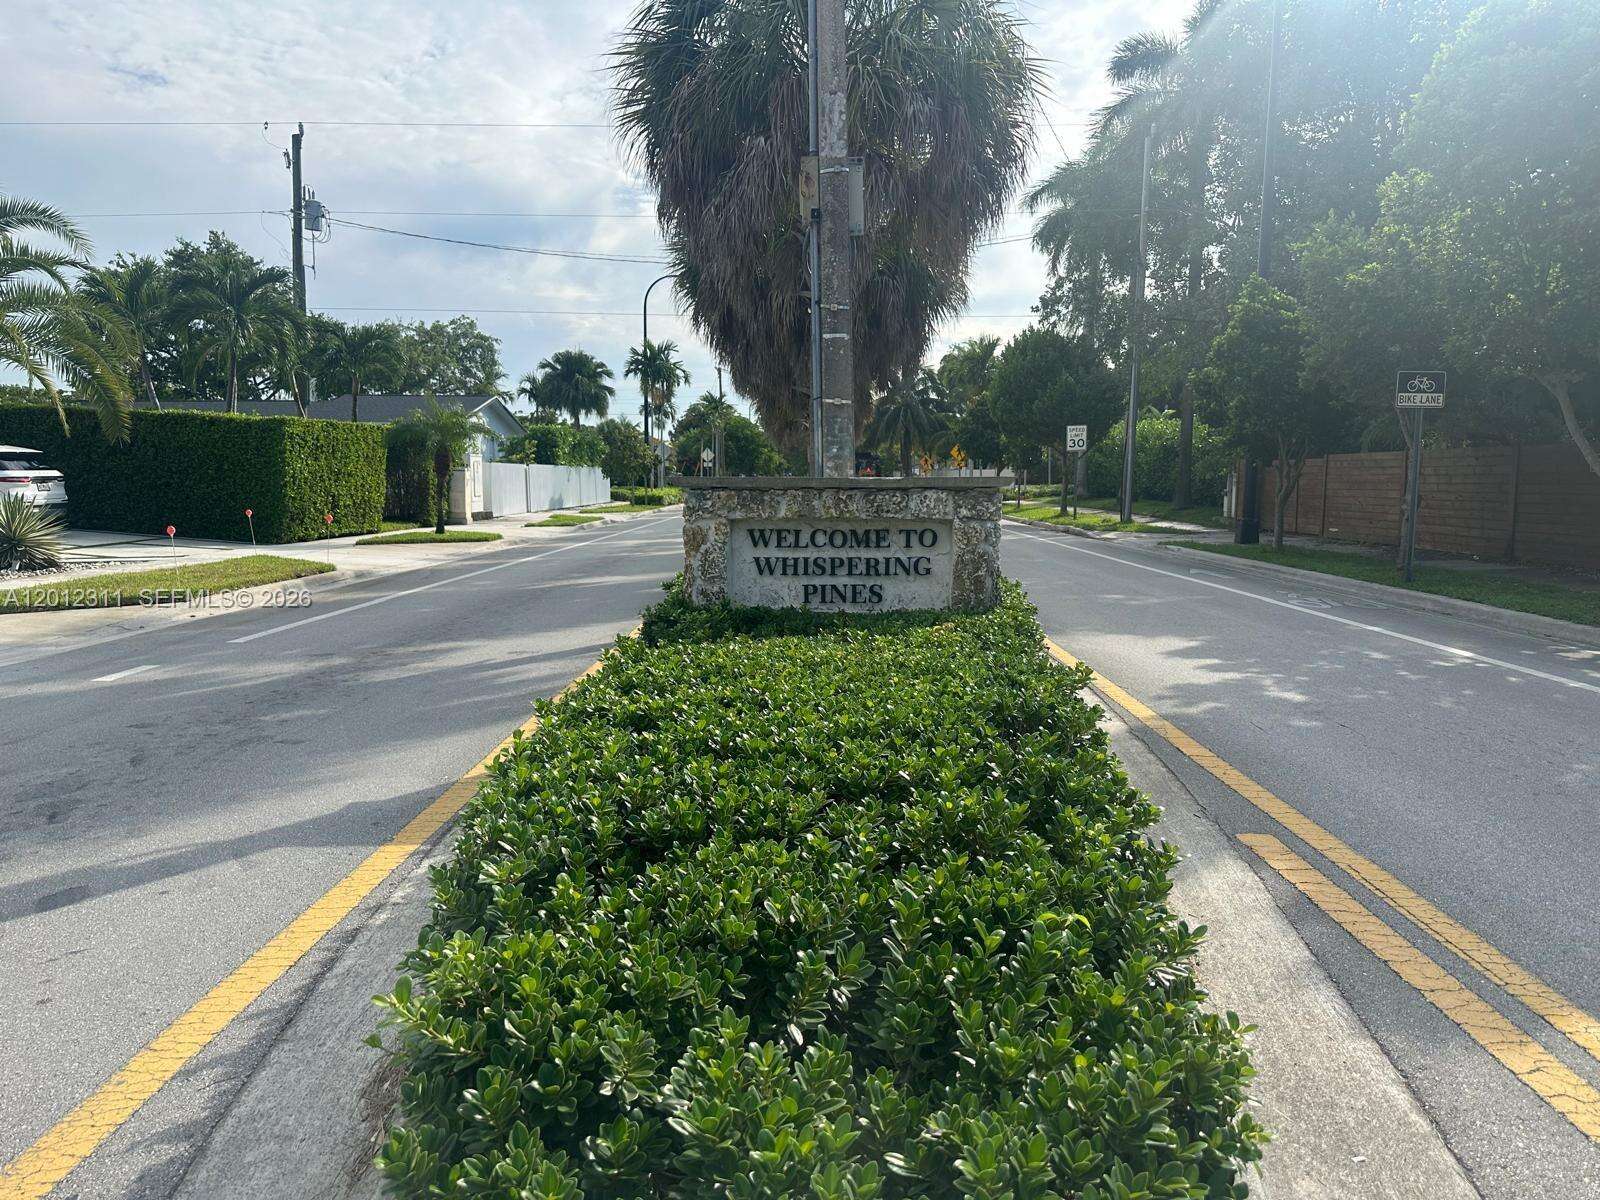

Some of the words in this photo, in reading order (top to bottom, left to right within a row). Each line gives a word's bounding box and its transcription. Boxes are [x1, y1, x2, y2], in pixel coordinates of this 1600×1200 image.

[1398, 394, 1418, 404] BIKE
[1419, 394, 1442, 404] LANE
[1068, 438, 1084, 448] 30
[747, 528, 891, 549] WELCOME
[898, 528, 938, 549] TO
[752, 556, 932, 578] WHISPERING
[802, 584, 883, 604] PINES
